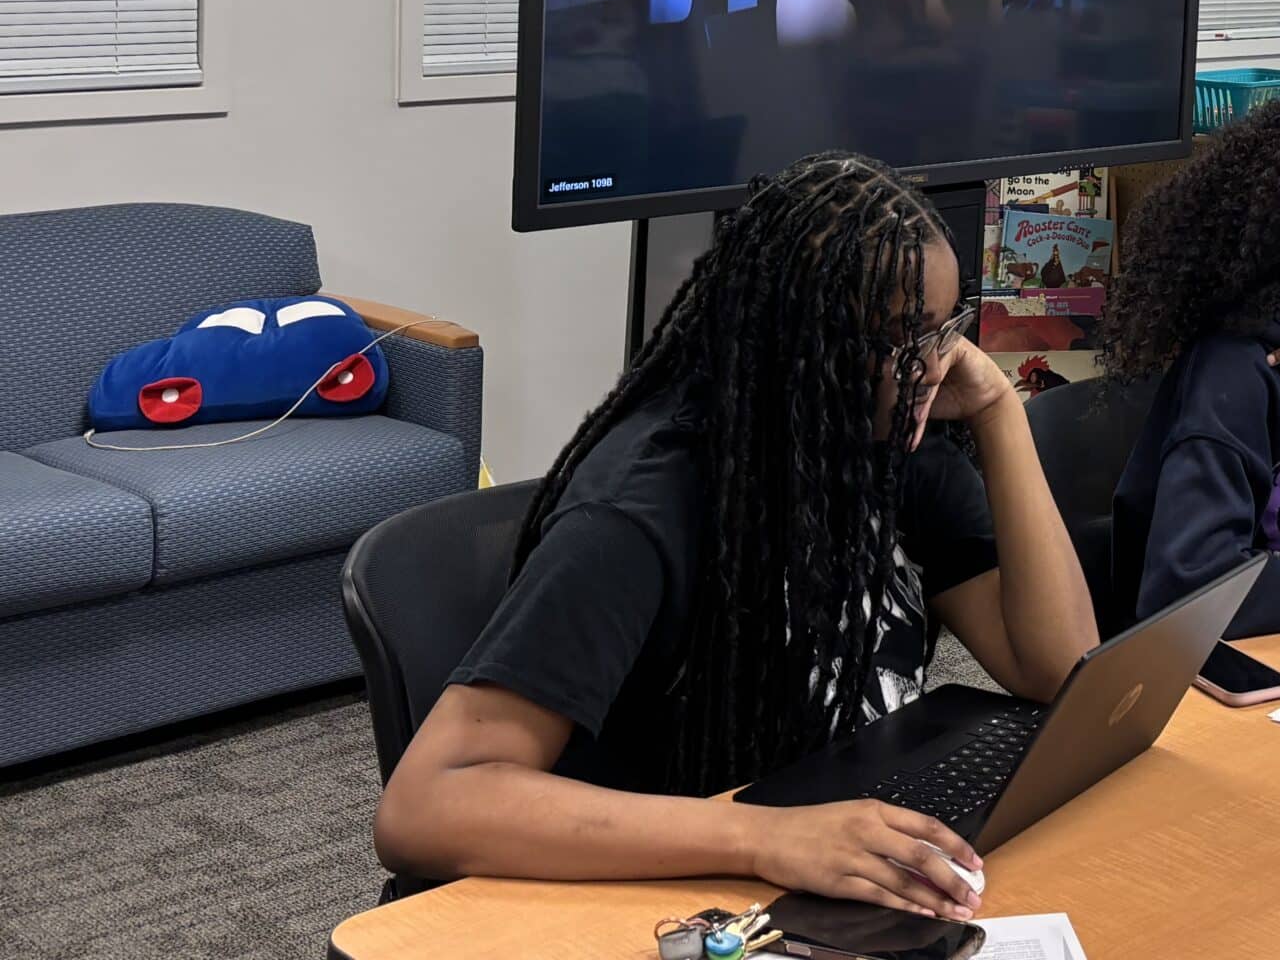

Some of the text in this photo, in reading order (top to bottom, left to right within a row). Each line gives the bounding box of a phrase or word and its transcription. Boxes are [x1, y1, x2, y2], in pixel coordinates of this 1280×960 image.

[1007, 175, 1050, 186] go to the
[548, 182, 589, 193] Jefferson
[1006, 187, 1035, 196] Moon
[1015, 219, 1066, 242] Rooster
